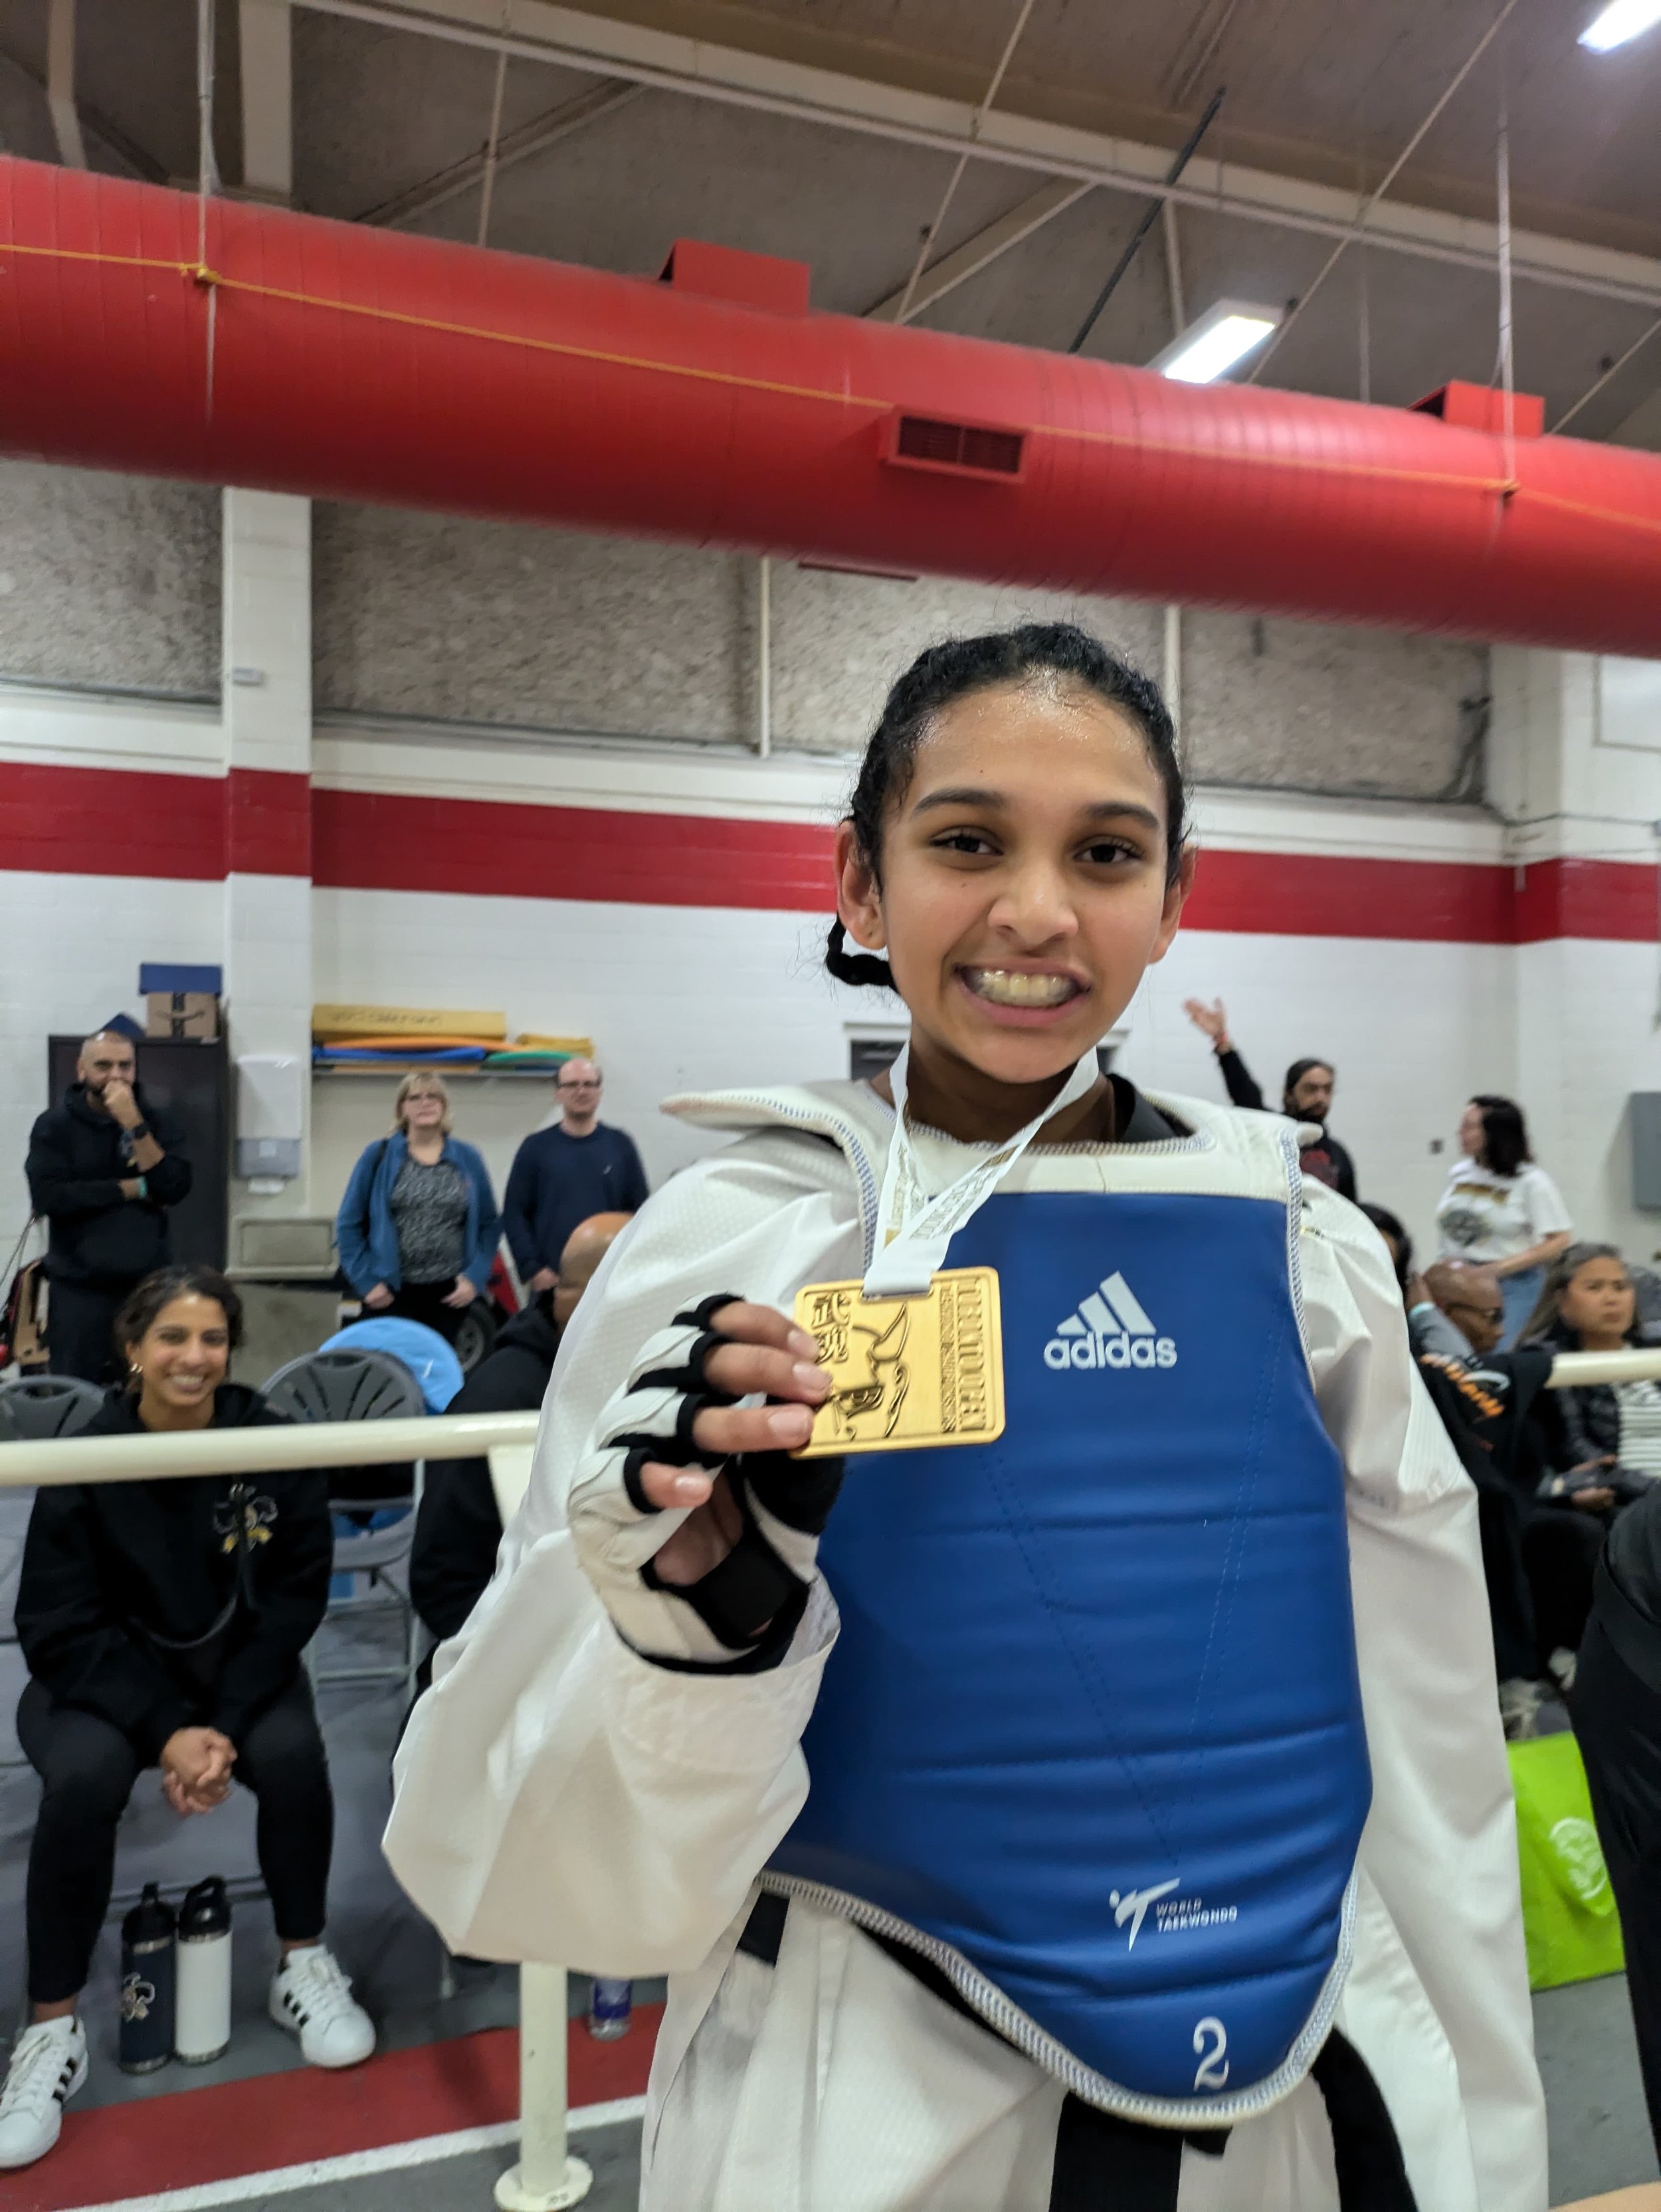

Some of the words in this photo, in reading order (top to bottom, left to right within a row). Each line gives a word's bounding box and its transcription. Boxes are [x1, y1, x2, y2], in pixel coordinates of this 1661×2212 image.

[1043, 1330, 1178, 1370] adidas
[1156, 1897, 1202, 1918] WORLD
[1157, 1905, 1238, 1934] TAEKWONDO
[1193, 2016, 1229, 2092] 2
